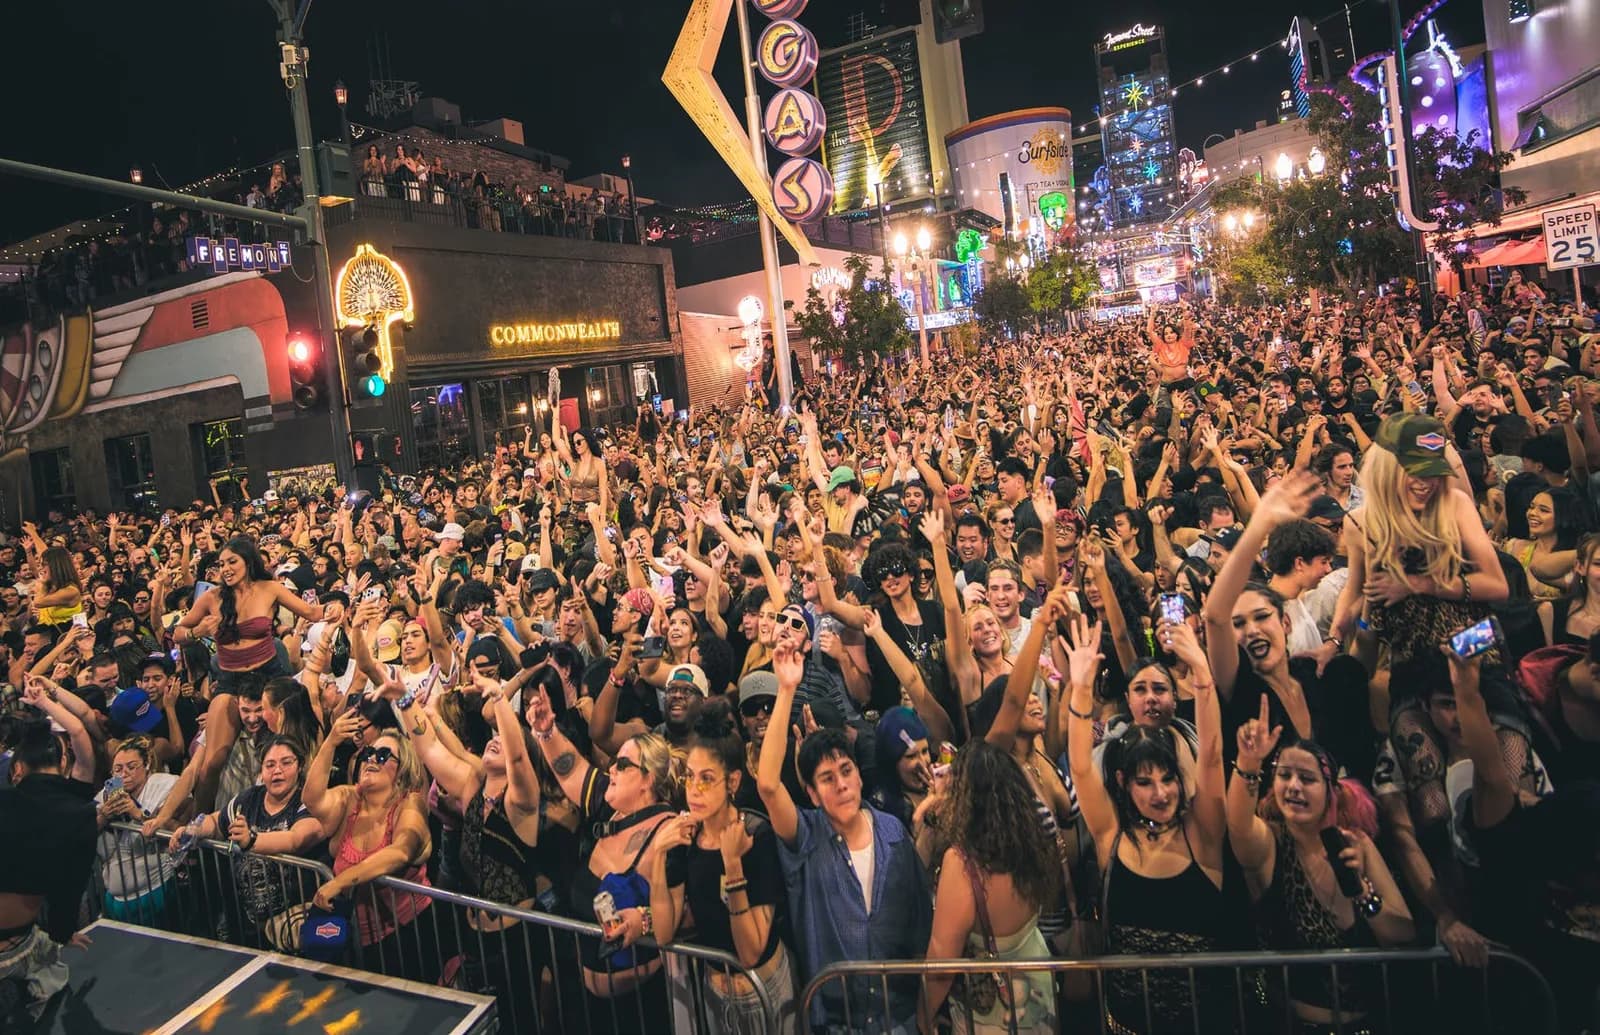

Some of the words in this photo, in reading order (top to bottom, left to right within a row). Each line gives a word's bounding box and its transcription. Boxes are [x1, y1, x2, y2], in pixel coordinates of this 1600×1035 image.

[1113, 38, 1145, 51] EXPERIENCE
[901, 40, 915, 93] VEGAS
[907, 100, 920, 128] LAS
[831, 130, 848, 148] the
[1018, 140, 1069, 164] Surfside
[1547, 212, 1592, 227] SPEED
[1553, 224, 1588, 238] LIMIT
[199, 245, 288, 264] FREMONT
[1552, 236, 1595, 262] 25
[491, 321, 621, 344] COMMONWEALTH
